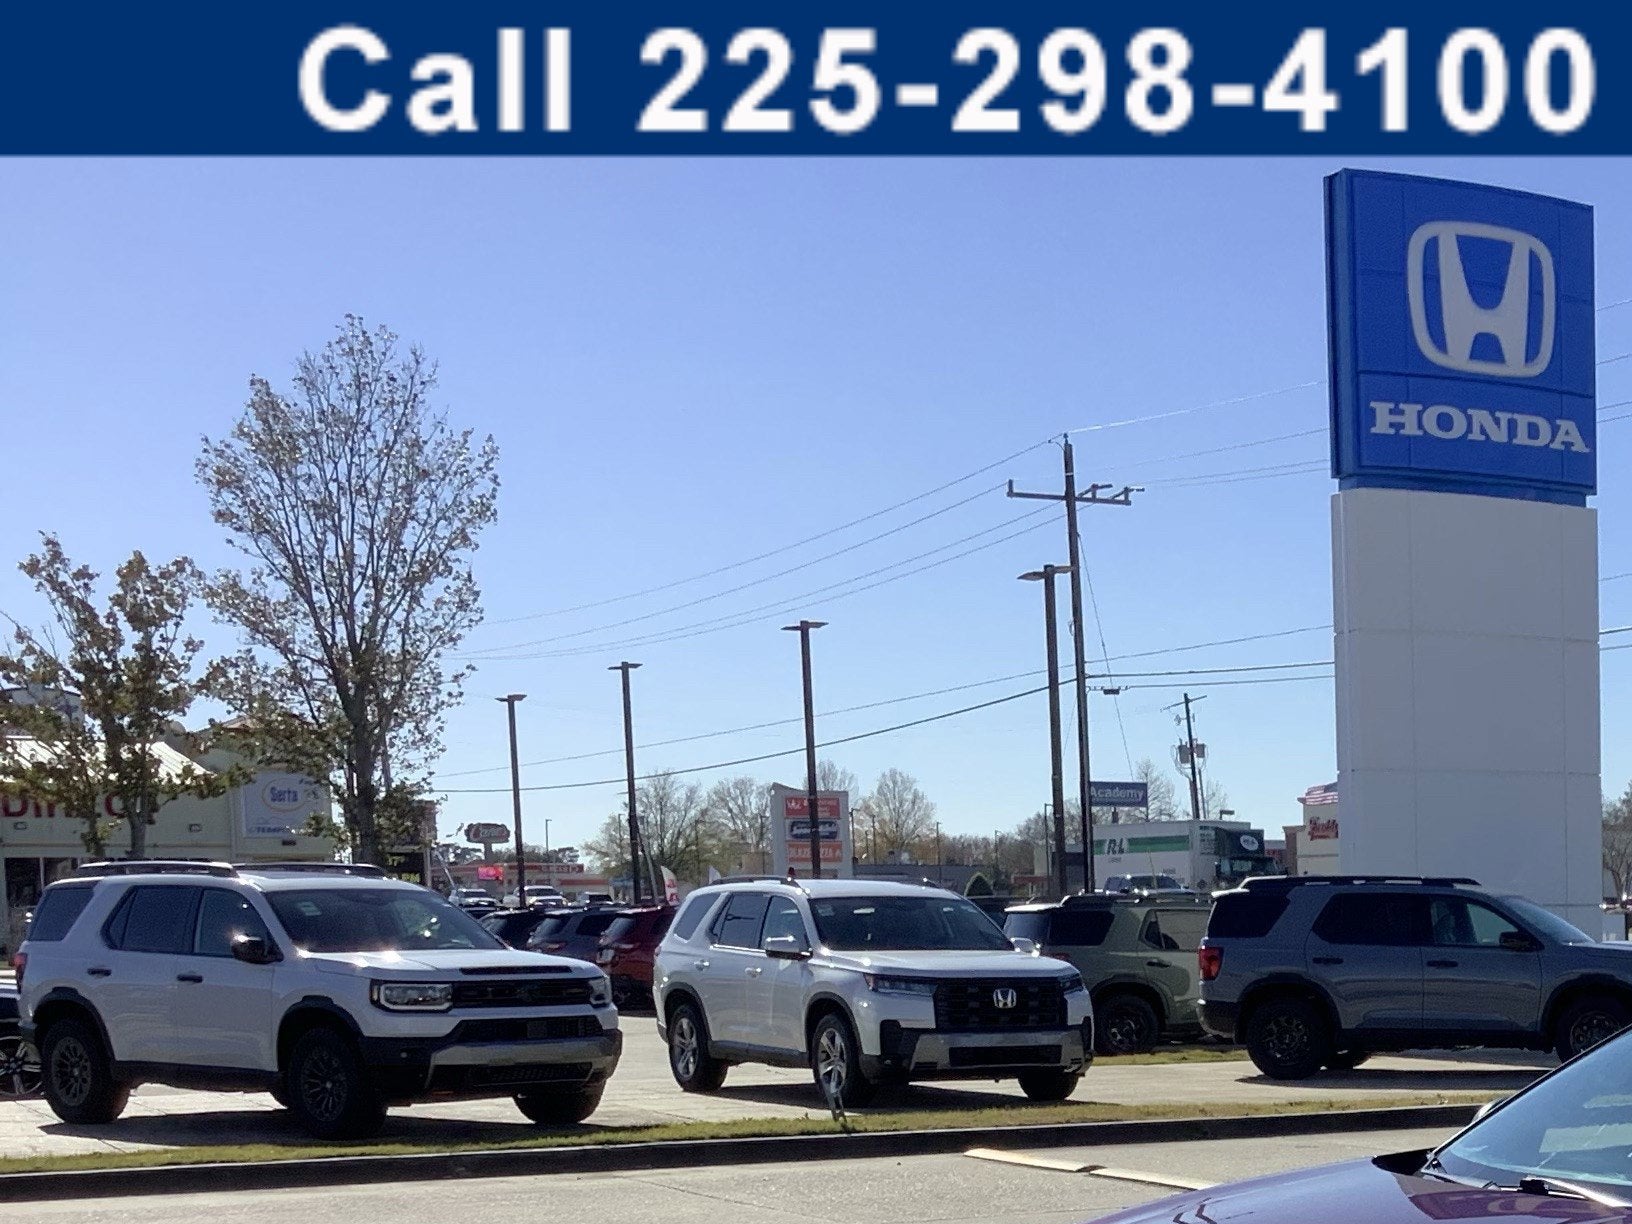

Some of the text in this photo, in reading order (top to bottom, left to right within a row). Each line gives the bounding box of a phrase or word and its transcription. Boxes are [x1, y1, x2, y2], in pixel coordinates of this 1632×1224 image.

[1369, 400, 1591, 453] HONDA
[270, 786, 299, 802] Serta
[1090, 786, 1144, 801] Academy
